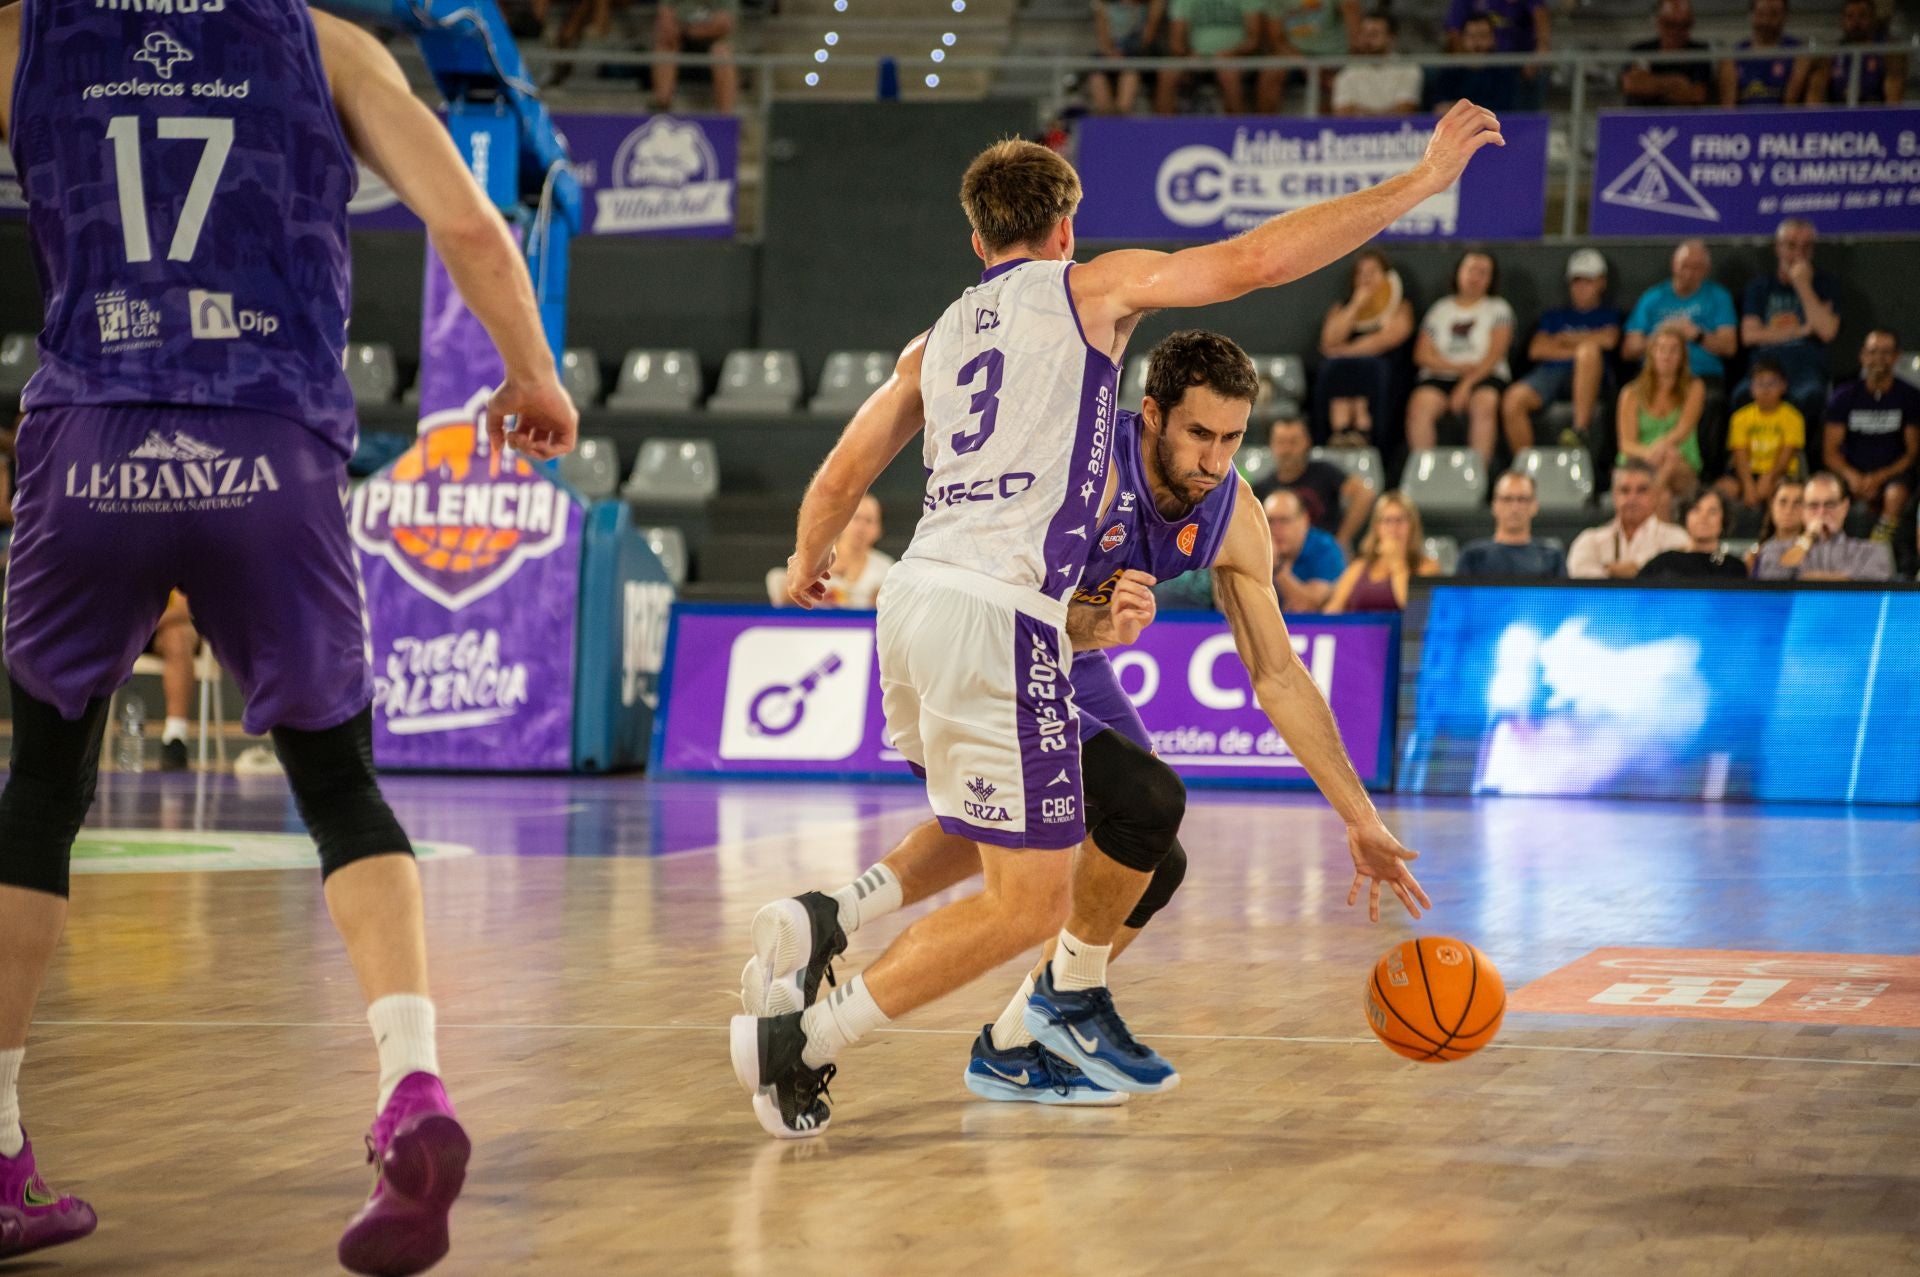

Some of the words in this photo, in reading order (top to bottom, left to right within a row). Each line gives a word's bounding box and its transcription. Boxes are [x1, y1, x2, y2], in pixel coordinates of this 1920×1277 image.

[83, 77, 185, 100] recoletas
[192, 77, 249, 98] salud
[1691, 133, 1750, 161] FRIO
[105, 115, 234, 263] 17
[1280, 173, 1386, 196] CRIST
[951, 347, 1005, 456] 3
[1088, 386, 1108, 475] aspasia
[65, 455, 280, 499] LEBANZA
[188, 496, 246, 511] NATURAL
[364, 481, 556, 532] PALENCIA
[373, 662, 528, 717] PALENCIA
[1219, 726, 1254, 754] de
[964, 800, 1012, 821] CRZA
[1042, 795, 1075, 818] CBC
